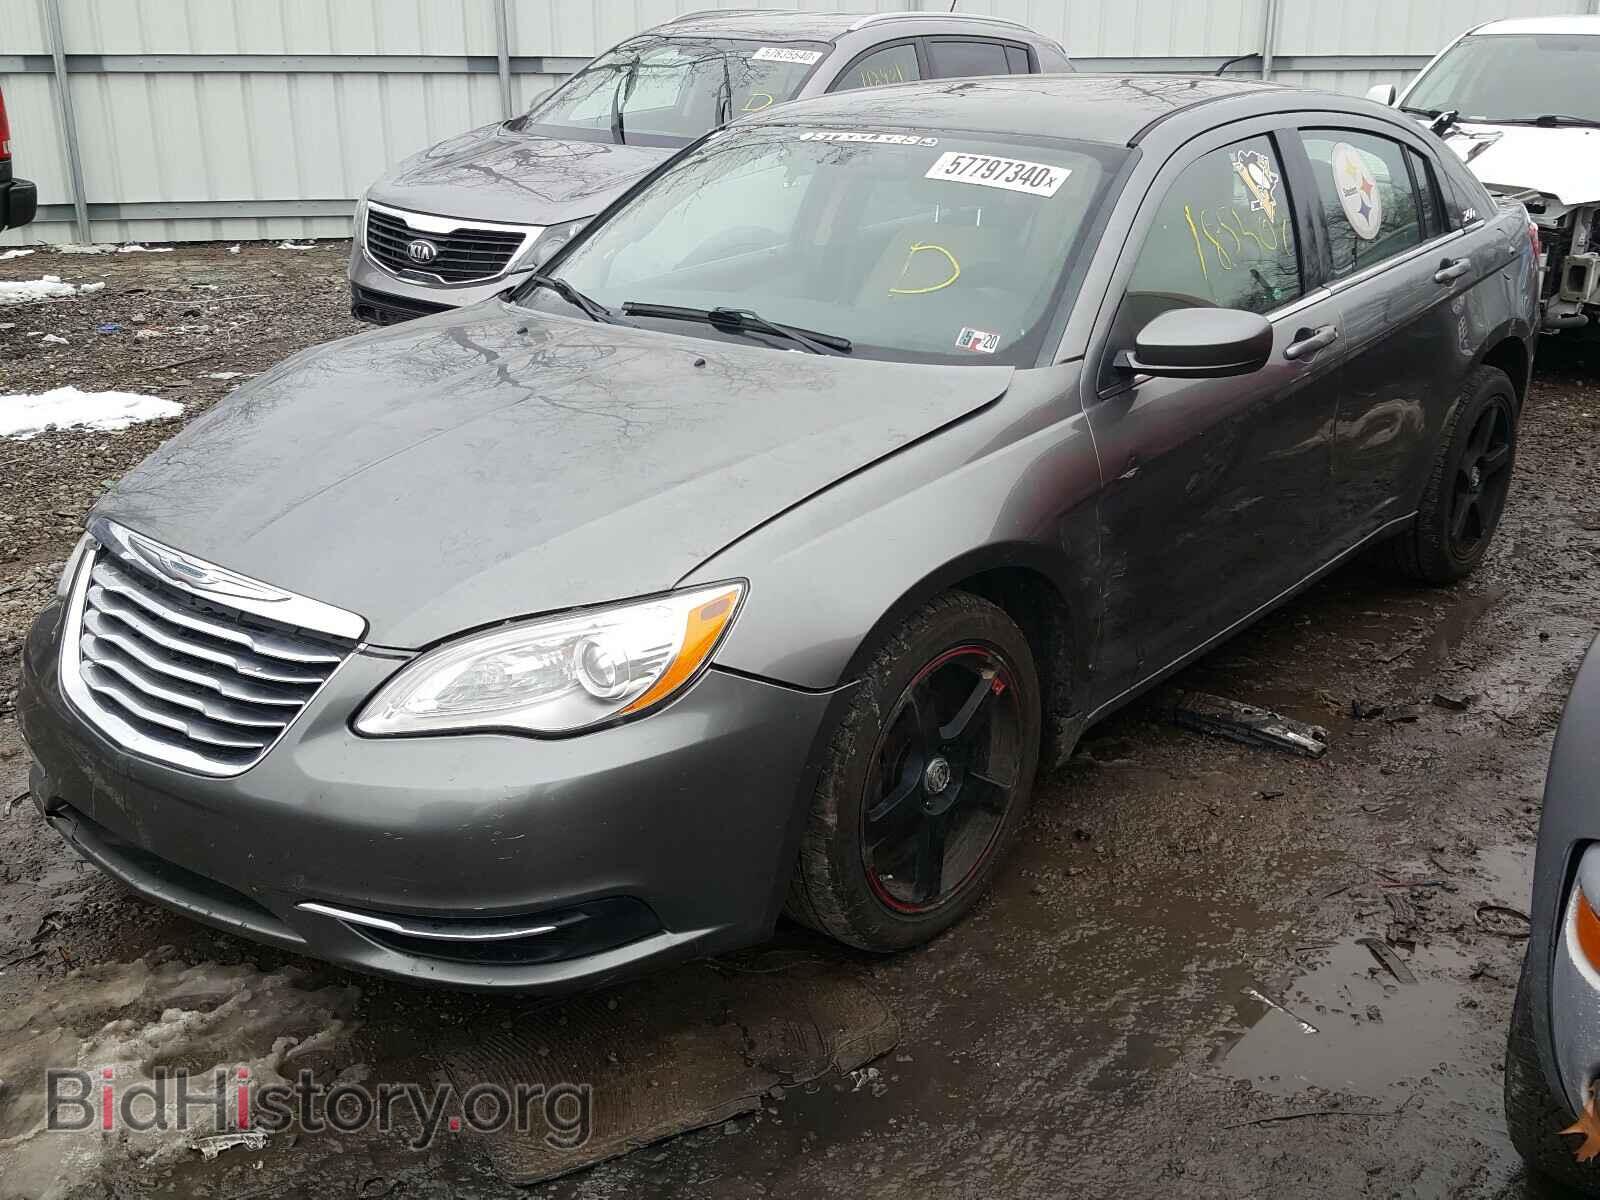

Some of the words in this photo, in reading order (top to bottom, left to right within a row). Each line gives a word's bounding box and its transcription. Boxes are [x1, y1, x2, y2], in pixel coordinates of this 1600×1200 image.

[739, 93, 773, 112] D
[409, 244, 430, 260] KIA
[887, 243, 960, 296] D
